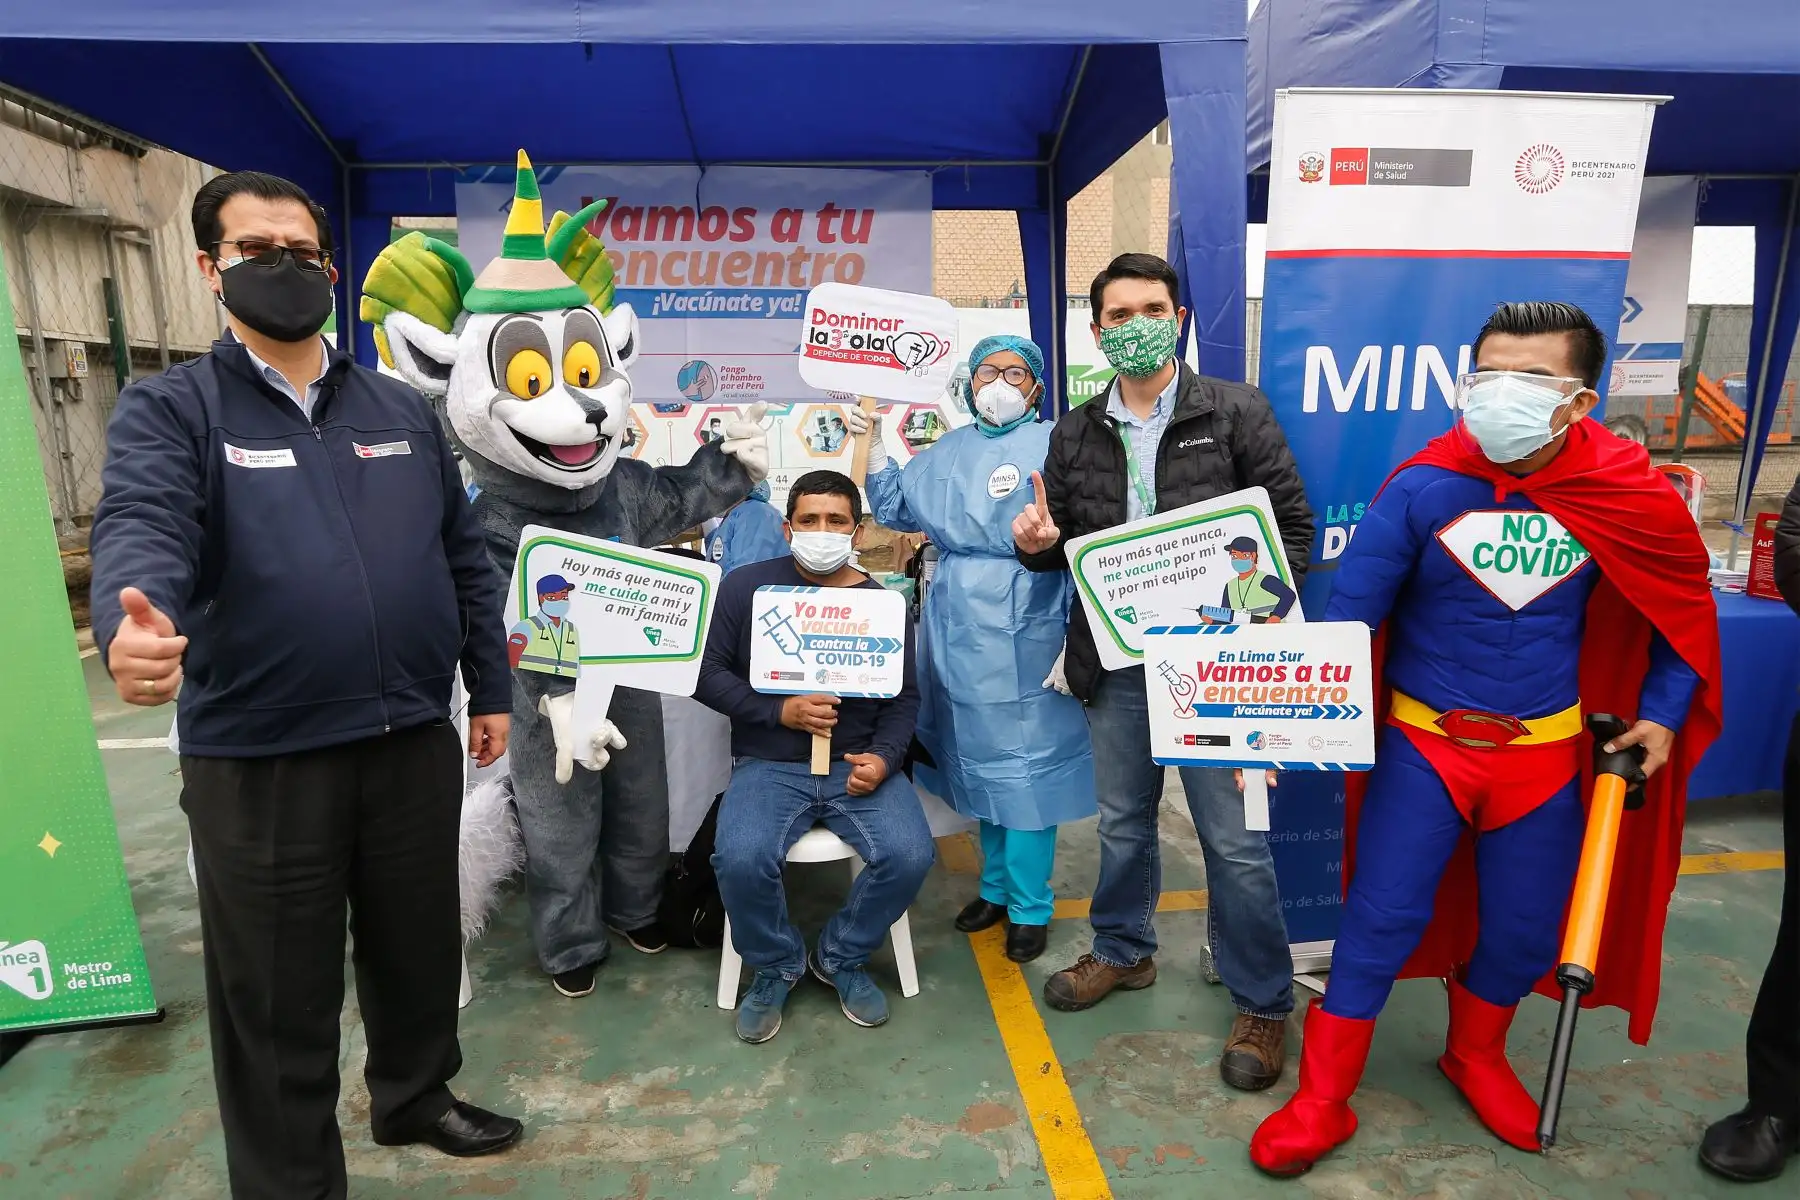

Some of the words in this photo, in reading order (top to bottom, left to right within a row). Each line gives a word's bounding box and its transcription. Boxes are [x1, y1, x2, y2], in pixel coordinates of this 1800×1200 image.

[1335, 159, 1364, 172] PERÚ
[1374, 161, 1414, 170] Ministerio
[1571, 170, 1594, 178] PERÚ
[1572, 161, 1636, 170] BICENTENARIO
[1374, 171, 1384, 179] de
[1385, 171, 1407, 180] Salud
[581, 196, 757, 242] Vamos
[770, 207, 804, 243] a
[816, 201, 875, 244] tu
[652, 290, 763, 315] ¡Vacúnate
[768, 293, 801, 316] ya!
[811, 308, 904, 332] Dominar
[809, 327, 829, 345] la
[850, 332, 885, 351] ola
[812, 348, 848, 360] DEPENDE
[850, 353, 862, 361] DE
[863, 354, 891, 364] TODOS
[720, 365, 746, 375] Pongo
[1302, 344, 1472, 412] MIN
[720, 383, 736, 391] por
[737, 382, 745, 390] el
[746, 381, 764, 390] Perú
[775, 474, 788, 484] 44
[991, 474, 1016, 484] MINSA
[1326, 504, 1348, 524] LA
[1501, 514, 1547, 543] NO
[1098, 555, 1122, 569] Hoy
[1125, 545, 1152, 562] más
[1155, 541, 1179, 557] que
[1181, 528, 1227, 548] nunca,
[1103, 572, 1122, 583] me
[1125, 559, 1171, 578] vacuno
[1174, 552, 1196, 567] por
[561, 557, 590, 576] Hoy
[592, 564, 621, 580] más
[624, 572, 650, 587] que
[653, 579, 695, 596] nunca
[1107, 589, 1115, 601] y
[1118, 583, 1140, 599] por
[1162, 565, 1207, 585] equipo
[585, 581, 606, 594] me
[609, 585, 648, 602] cuido
[650, 594, 659, 605] a
[682, 601, 691, 612] y
[605, 603, 613, 613] a
[617, 604, 636, 617] mi
[635, 605, 688, 627] familia
[794, 601, 816, 618] Yo
[821, 606, 852, 619] me
[801, 618, 870, 635] vacuné
[809, 638, 853, 650] contra
[855, 639, 869, 651] la
[815, 652, 885, 667] COVID-19
[1218, 650, 1235, 663] En
[1239, 650, 1275, 663] Lima
[1279, 650, 1304, 662] Sur
[1196, 661, 1287, 683] Vamos
[1295, 665, 1312, 683] a
[1319, 661, 1352, 683] tu
[1204, 683, 1348, 704] encuentro
[1233, 704, 1292, 718] ¡Vacúnate
[1293, 706, 1313, 719] ya!
[1303, 829, 1320, 841] de
[1324, 828, 1345, 841] Sal
[1296, 896, 1313, 908] de
[1316, 893, 1344, 906] Salu
[0, 951, 40, 966] nea
[64, 961, 112, 976] Metro
[27, 967, 47, 993] 1
[67, 976, 87, 990] de
[91, 973, 132, 987] Lima
